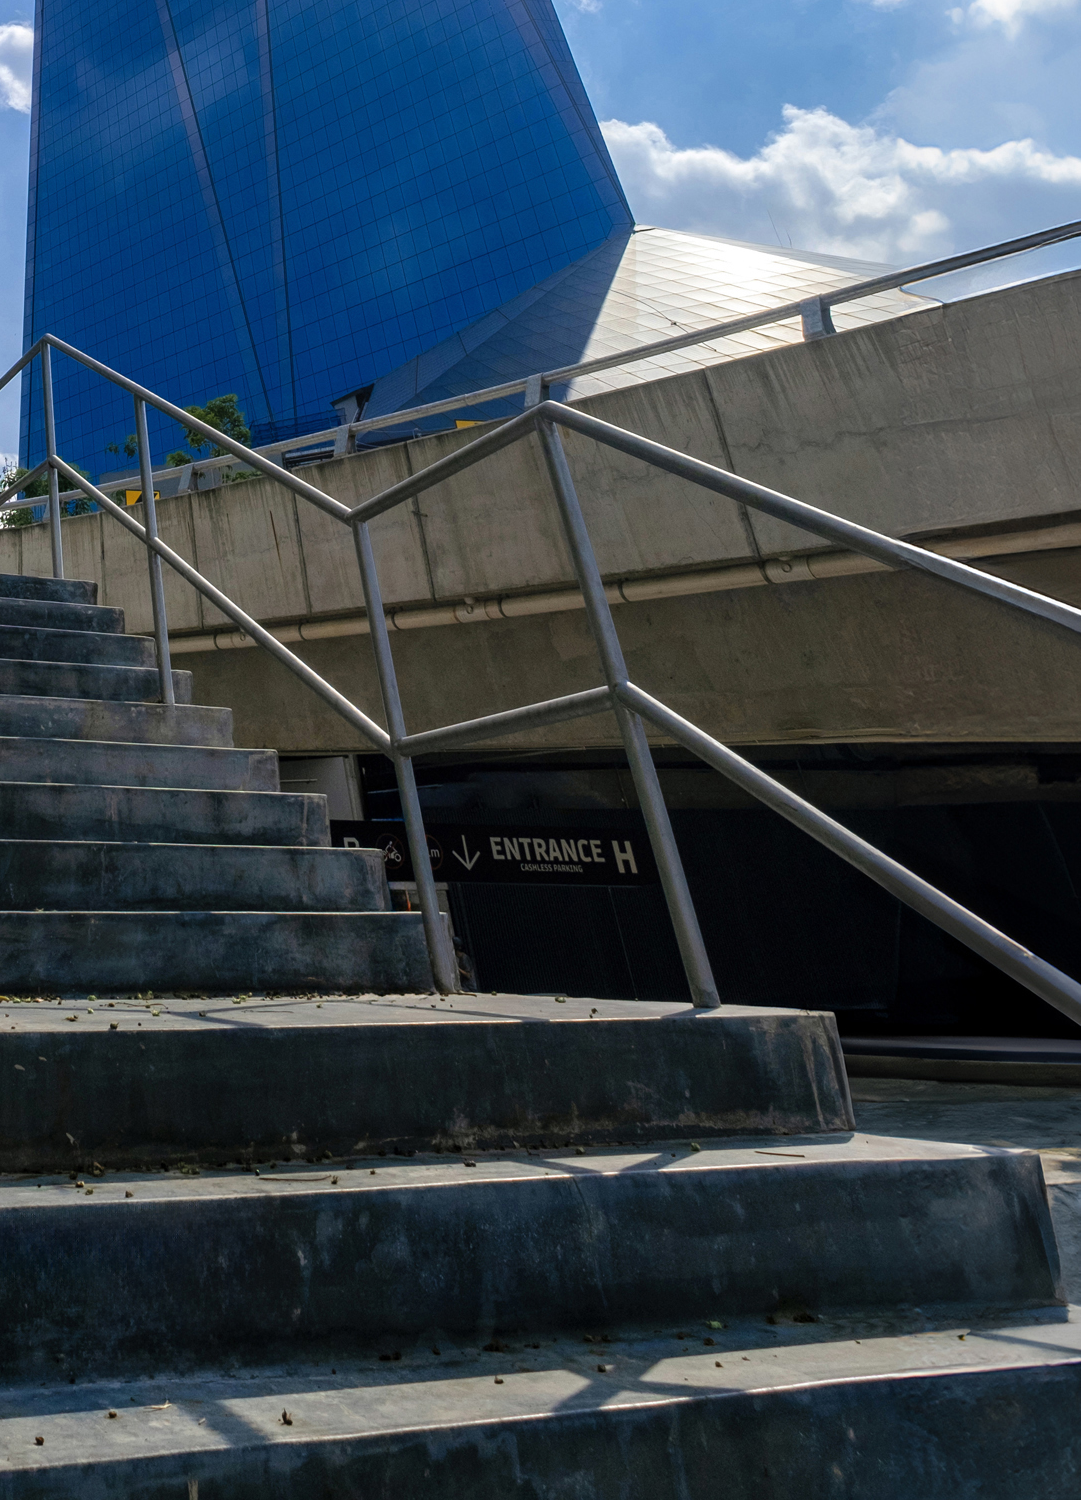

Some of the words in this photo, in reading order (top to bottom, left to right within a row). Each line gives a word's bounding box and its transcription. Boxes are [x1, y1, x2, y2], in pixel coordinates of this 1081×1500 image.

[489, 836, 606, 863] ENTRANCE
[611, 840, 638, 874] H
[520, 863, 553, 872] CASHLESS
[553, 864, 583, 873] PARKING
